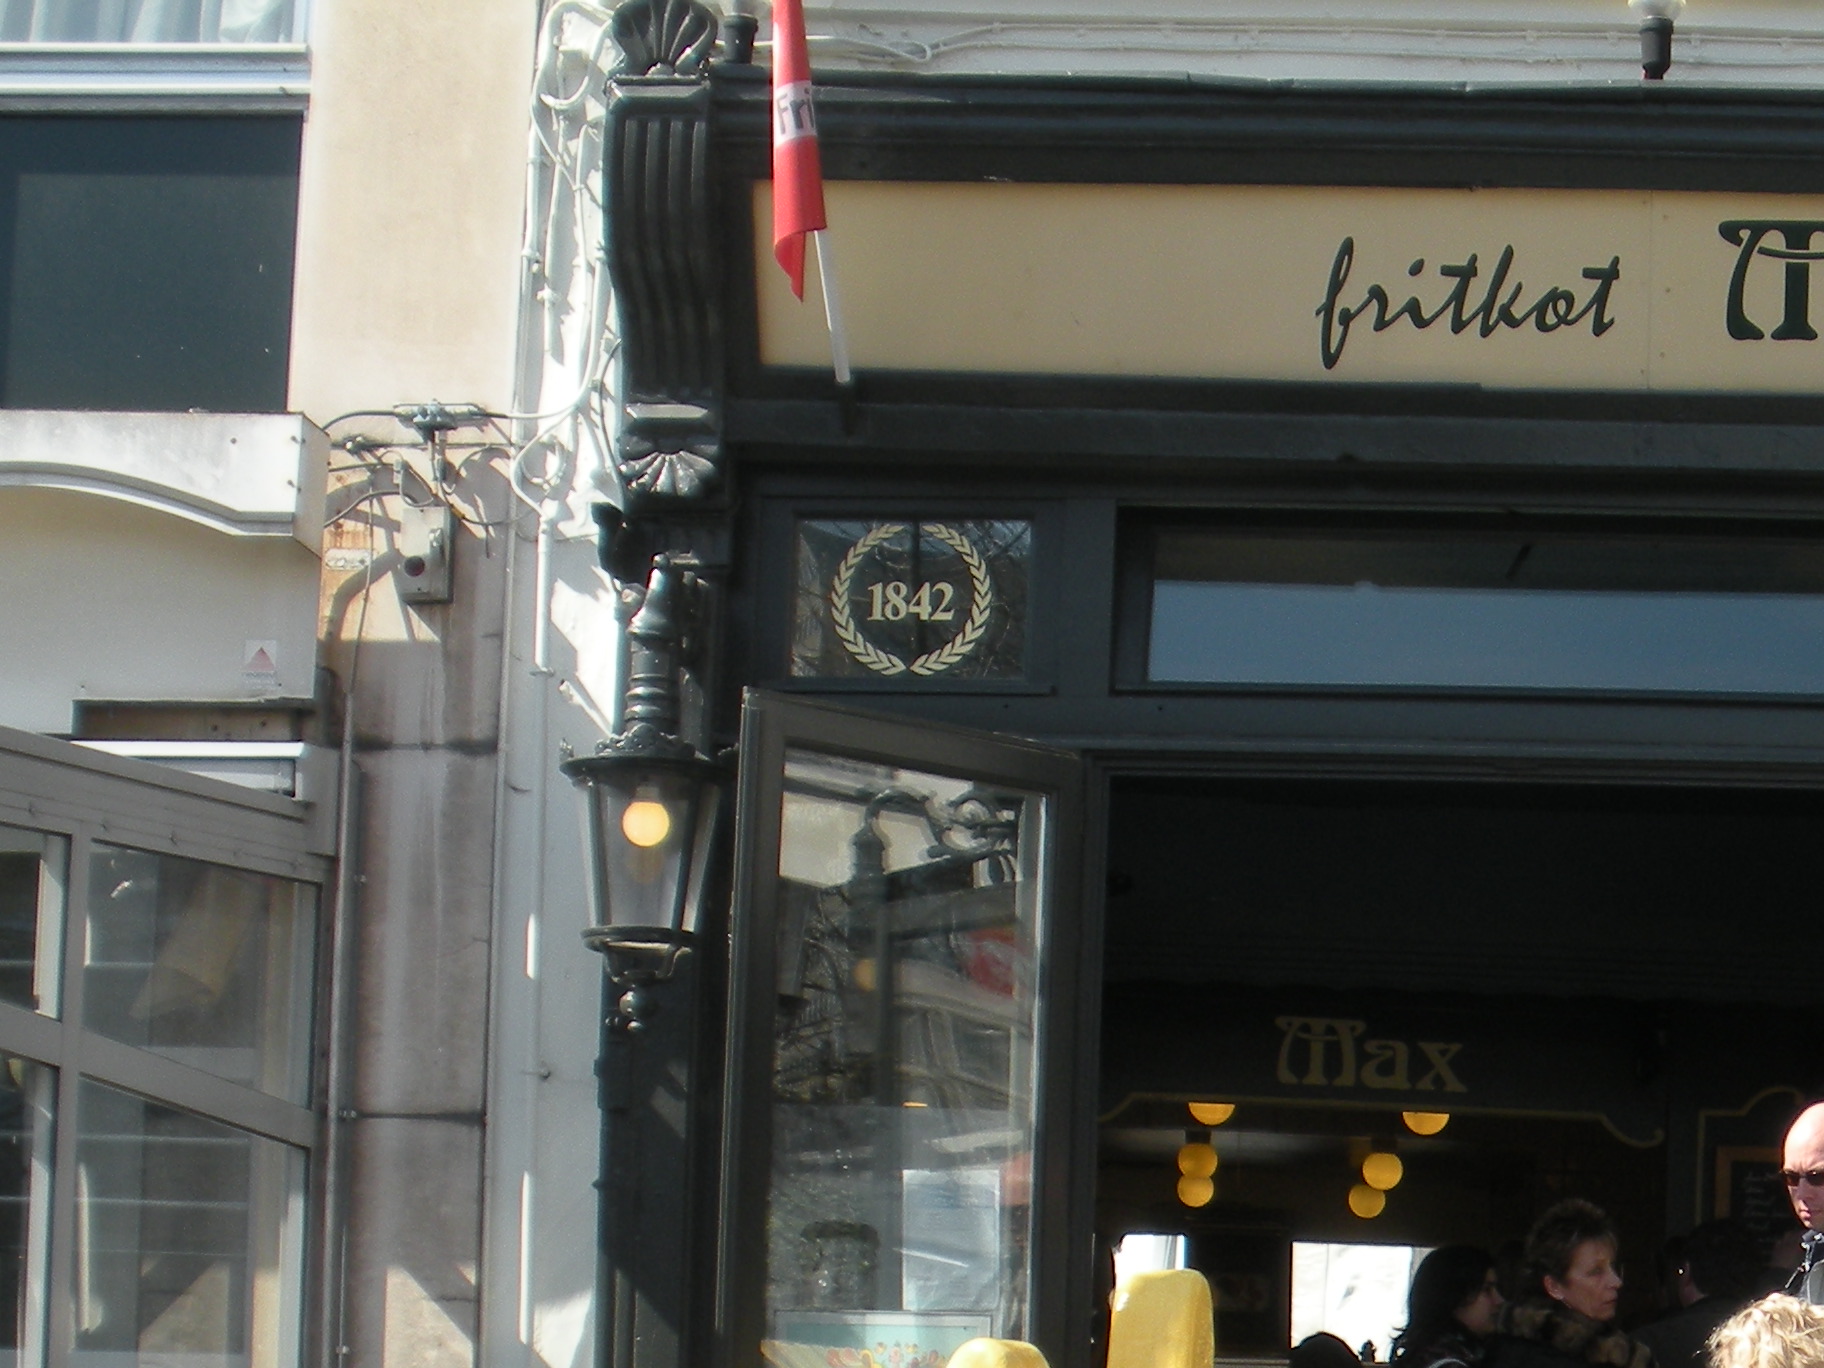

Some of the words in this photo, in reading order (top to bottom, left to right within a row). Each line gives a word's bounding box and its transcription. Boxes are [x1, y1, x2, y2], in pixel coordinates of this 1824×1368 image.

[1315, 236, 1621, 370] fritkot
[867, 581, 955, 622] 1842
[1274, 1015, 1468, 1093] Max
